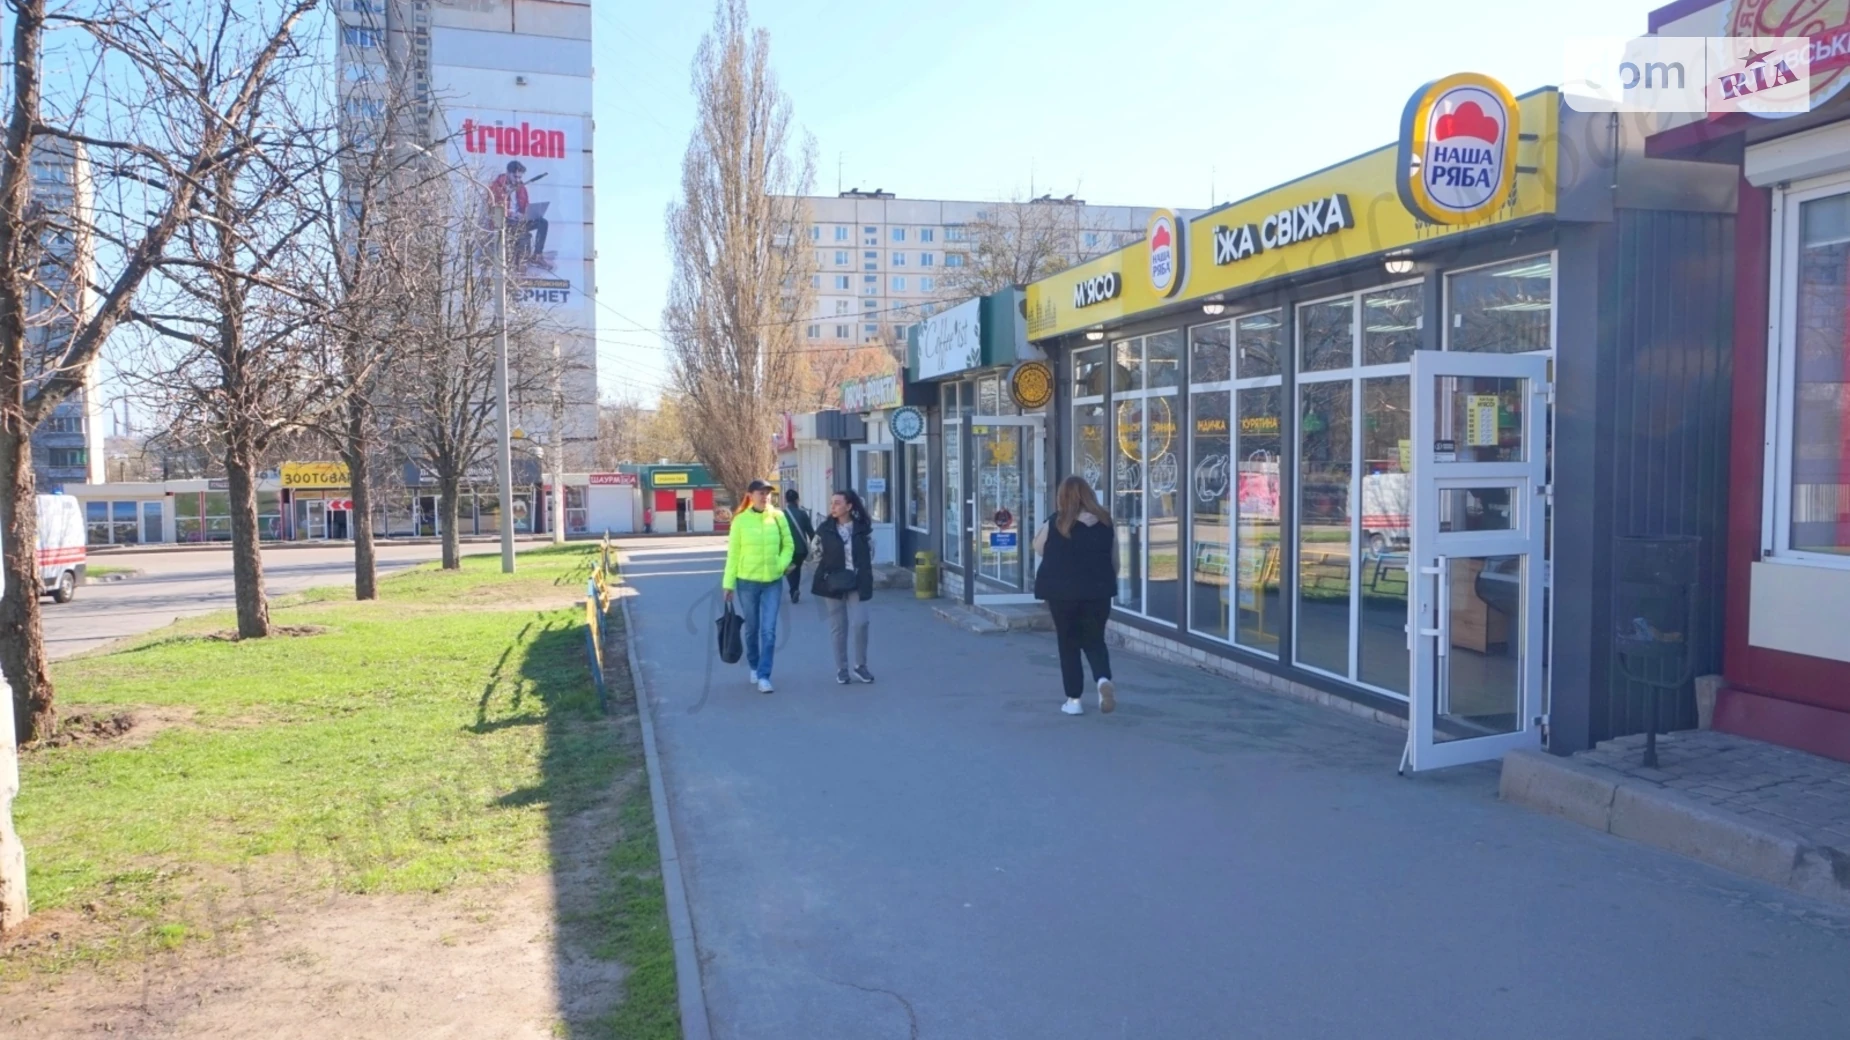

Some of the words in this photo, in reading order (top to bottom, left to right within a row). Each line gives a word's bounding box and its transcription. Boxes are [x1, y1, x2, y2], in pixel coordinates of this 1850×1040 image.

[463, 118, 565, 158] triolan
[1434, 146, 1493, 165] НАША
[1431, 166, 1491, 188] РЯБА
[1213, 224, 1255, 265] ЇЖА
[1261, 192, 1345, 249] СВІЖА
[1152, 250, 1170, 264] НАША
[1152, 262, 1171, 277] РЯБА
[1074, 272, 1114, 309] М'ЯСО
